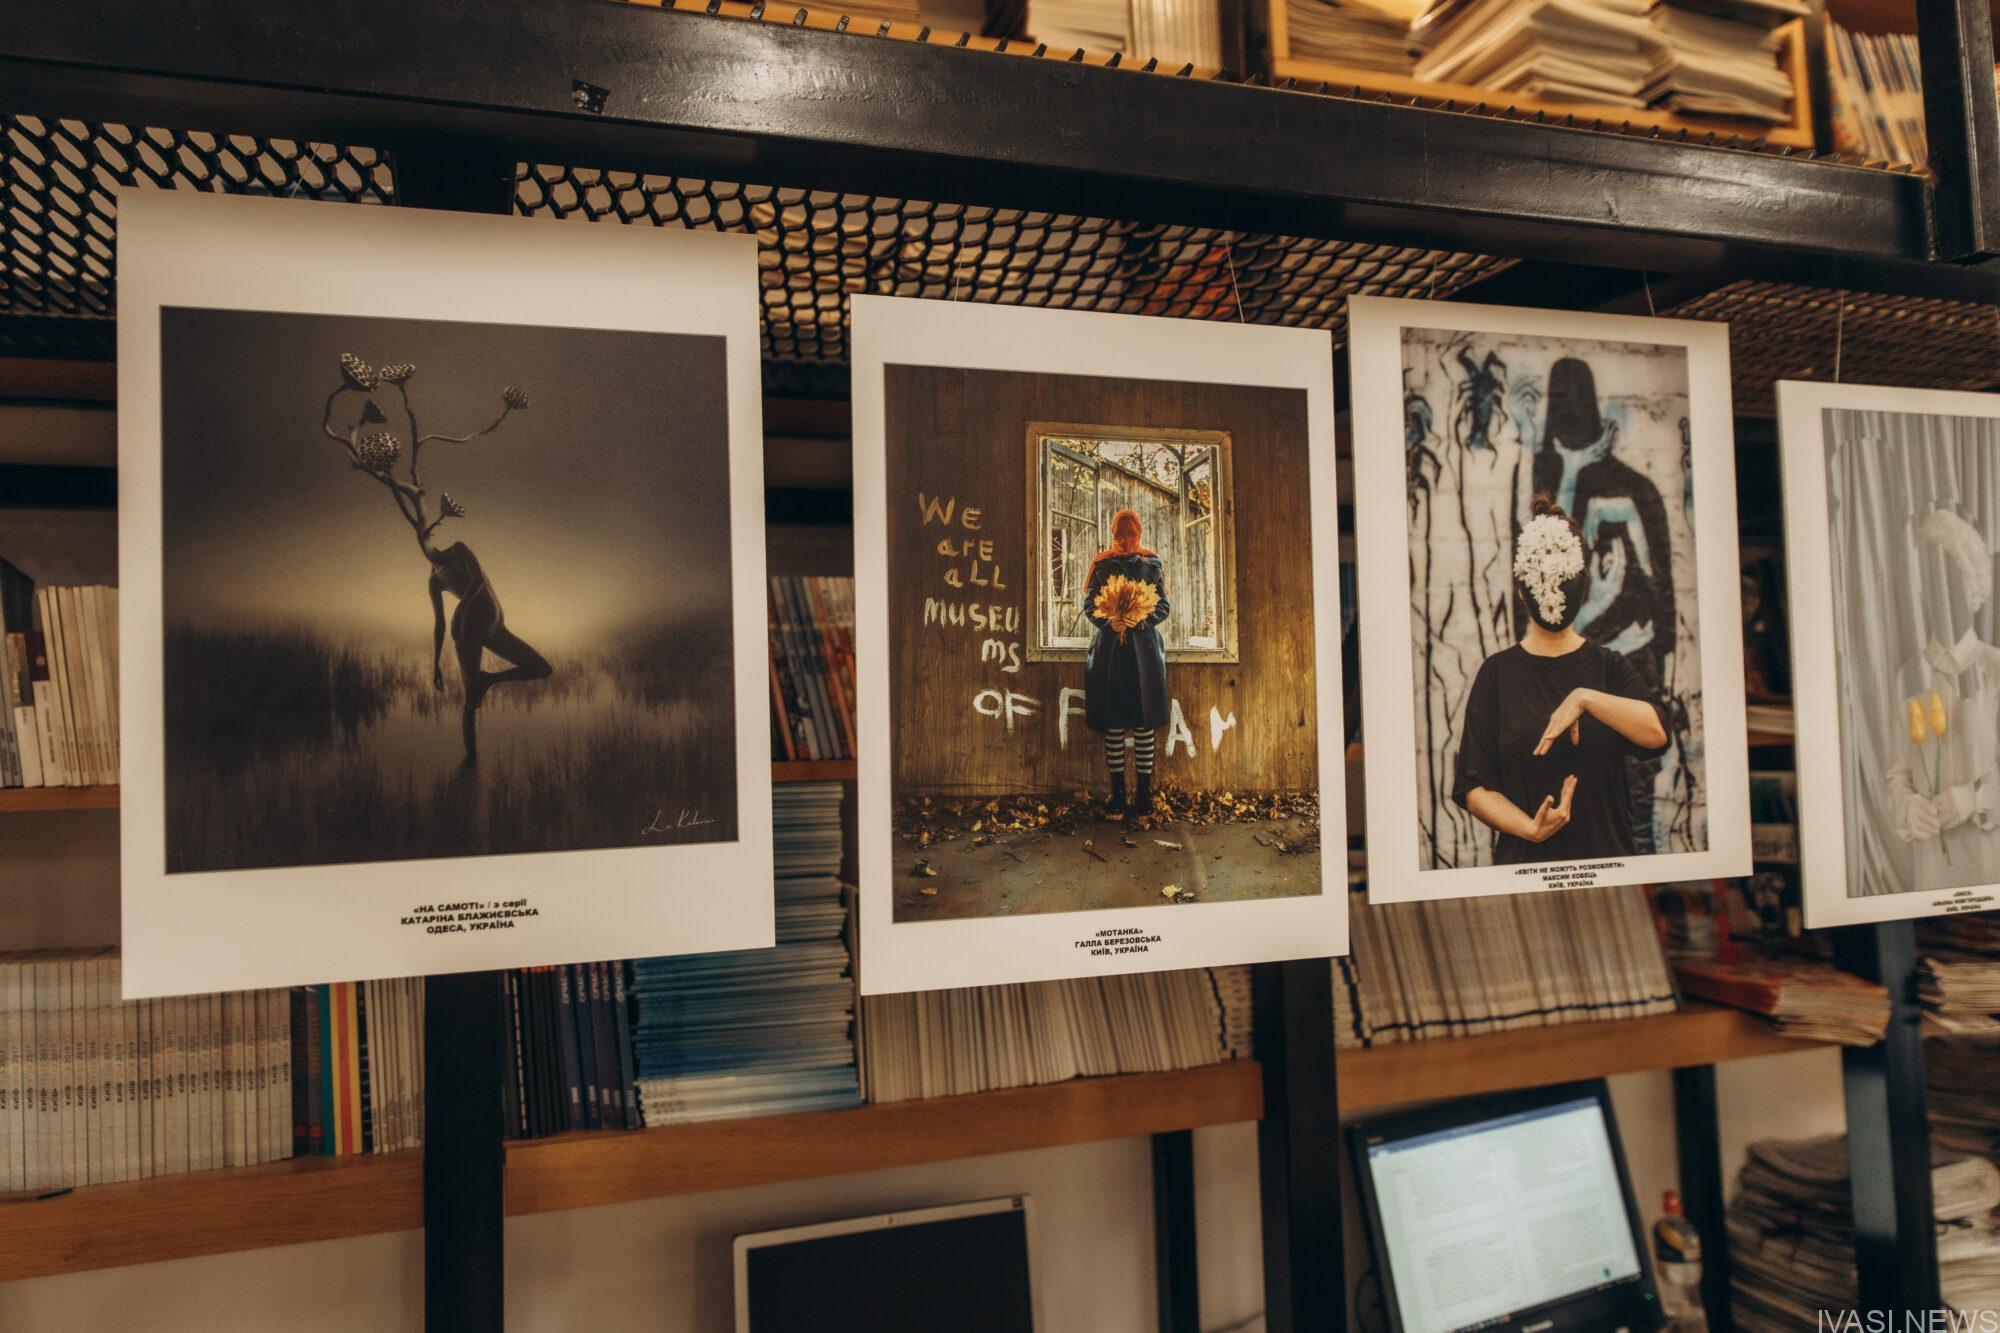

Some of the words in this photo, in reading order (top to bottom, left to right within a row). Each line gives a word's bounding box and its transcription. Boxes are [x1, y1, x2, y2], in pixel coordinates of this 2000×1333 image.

[1567, 880, 1594, 888] УКРАЇНА
[413, 904, 435, 914] «НА
[437, 902, 485, 912] САМОТІ»
[502, 899, 528, 909] серії
[401, 914, 454, 925] КАТАРІНА
[457, 908, 539, 921] БЛАЖИЄВСЬКА
[426, 924, 467, 935] ОДЕСА,
[469, 920, 515, 931] УКРАЇНА
[1095, 928, 1143, 937] «МОТАНКА»
[1075, 940, 1102, 948] ГАЛЛА
[1104, 935, 1161, 946] БЕРЕЗОВСЬКА
[1091, 947, 1113, 956] КИЇВ,
[1114, 945, 1149, 955] УКРАЇНА
